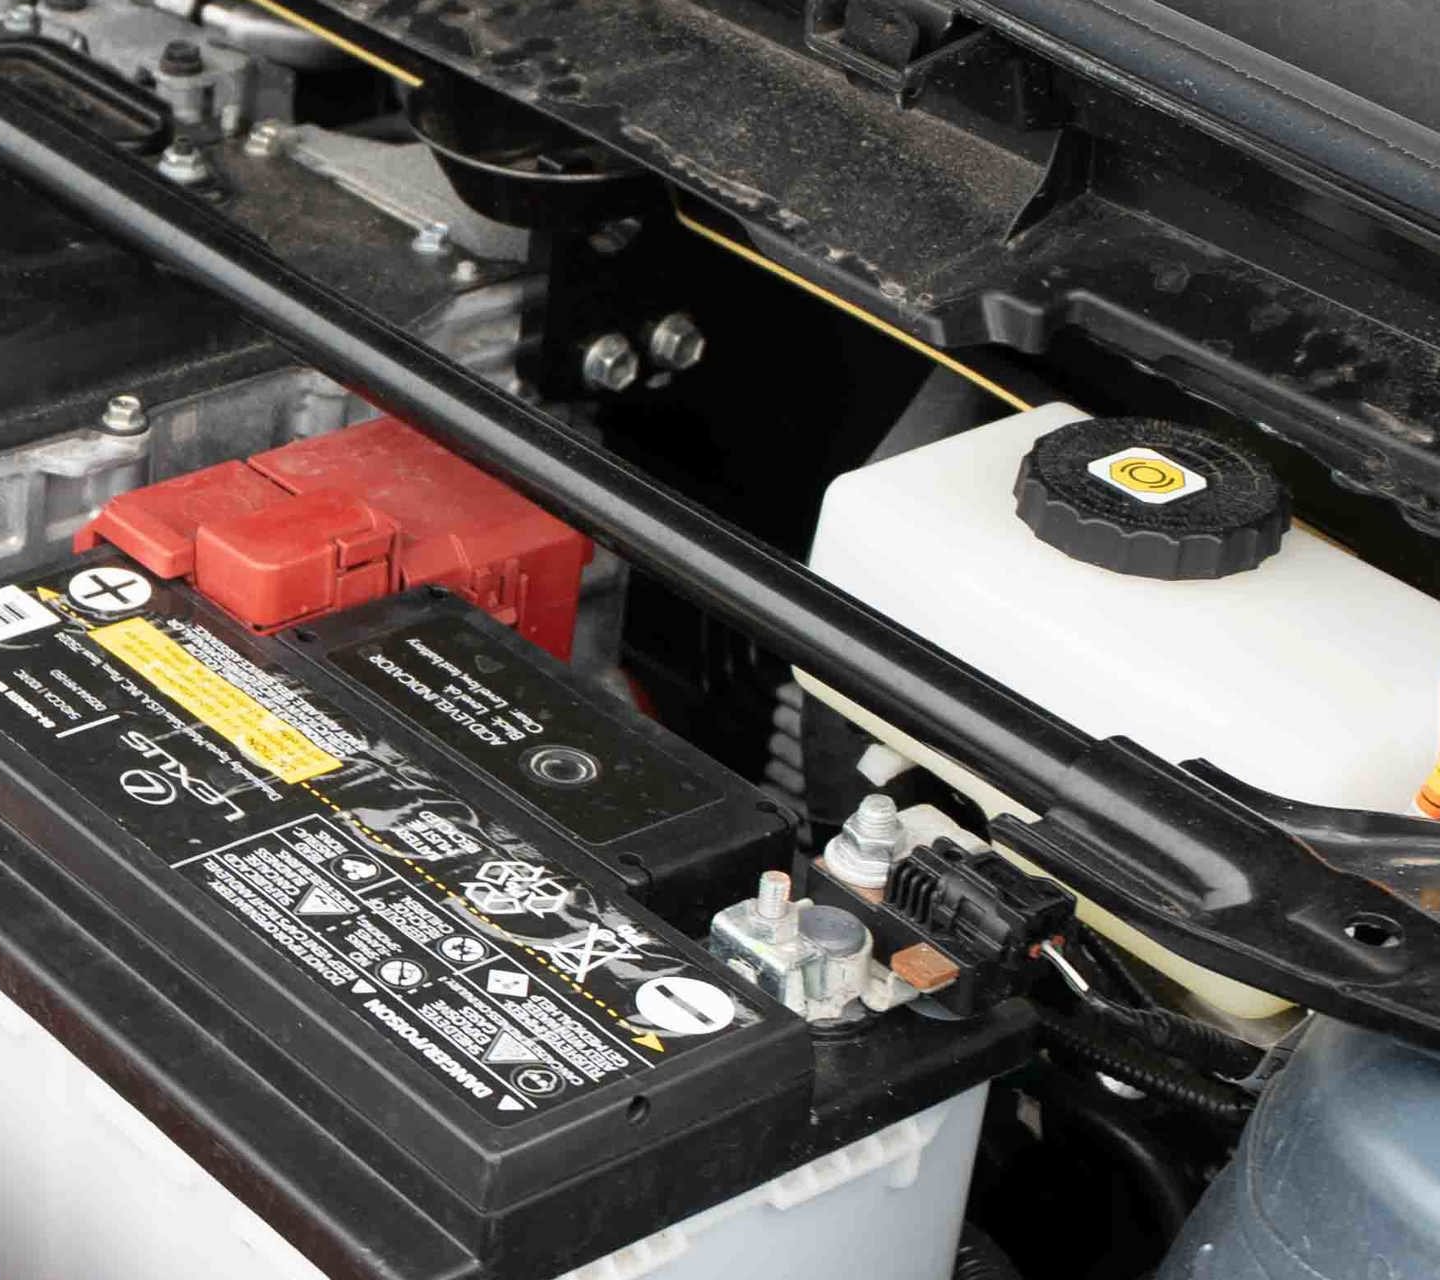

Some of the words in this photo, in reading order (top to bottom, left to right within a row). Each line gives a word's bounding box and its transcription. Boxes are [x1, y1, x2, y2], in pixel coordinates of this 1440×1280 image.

[405, 638, 444, 665] battery
[368, 653, 440, 701] INDICATOR
[437, 660, 462, 676] test
[452, 693, 490, 715] Level
[472, 686, 508, 709] Level
[434, 696, 476, 725] LEVEL
[508, 708, 544, 734] Clear:
[178, 725, 209, 746] Motor
[467, 722, 507, 745] ACID
[490, 715, 526, 741] Black:
[204, 741, 232, 764] Toyota
[120, 730, 244, 821] LEXUS
[227, 760, 243, 771] by
[417, 826, 460, 856] MUST
[418, 810, 481, 854] RECYCLED
[223, 852, 252, 872] ACID
[293, 841, 325, 864] READ
[242, 853, 280, 879] CAUSE
[253, 847, 308, 886] BLINDNESS
[227, 878, 257, 900] AND
[244, 868, 294, 906] SULFURIC
[271, 875, 300, 896] CAN
[243, 907, 279, 933] OPEN
[247, 895, 283, 922] TIGHT
[379, 907, 407, 927] OUT
[387, 902, 410, 914] OF
[274, 917, 308, 942] CAPS
[399, 923, 431, 945] KEEP
[402, 911, 443, 939] REACH
[272, 930, 294, 945] OR
[286, 942, 308, 957] TIP
[299, 937, 333, 961] VENT
[300, 953, 329, 973] NOT
[325, 958, 359, 980] KEEP
[348, 950, 372, 967] NO
[321, 969, 346, 986] DO
[430, 999, 491, 1045] EXPLOSIVE
[458, 1005, 501, 1034] GASES
[442, 1024, 484, 1055] SHIELD
[539, 1029, 573, 1054] EYES
[552, 1025, 587, 1050] WITH
[557, 1012, 609, 1052] MEDICAL
[364, 998, 492, 1097] DANGER/POISON
[578, 1047, 618, 1071] ATELY
[600, 1048, 629, 1067] GET
[563, 1048, 605, 1079] FLUSH
[556, 1066, 584, 1086] CAN
